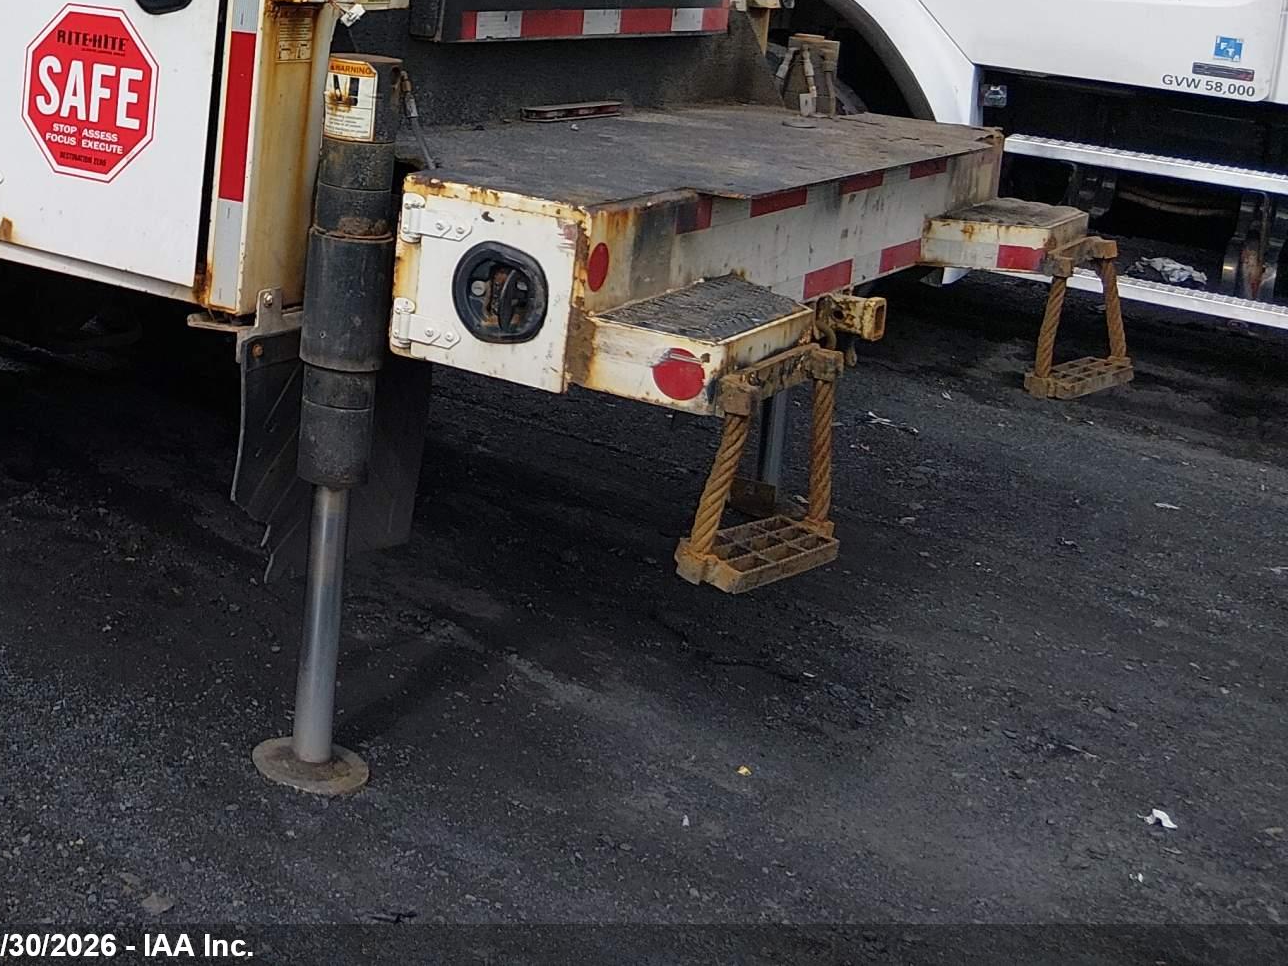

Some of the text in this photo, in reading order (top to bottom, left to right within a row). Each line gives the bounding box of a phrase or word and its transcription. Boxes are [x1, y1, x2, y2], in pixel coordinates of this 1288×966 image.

[335, 65, 372, 75] WARNING
[36, 55, 143, 130] SAFE
[1162, 74, 1255, 97] GVW 58,000
[45, 132, 123, 154] FOCUS EXECUTE
[52, 123, 118, 142] STOP ASSESS
